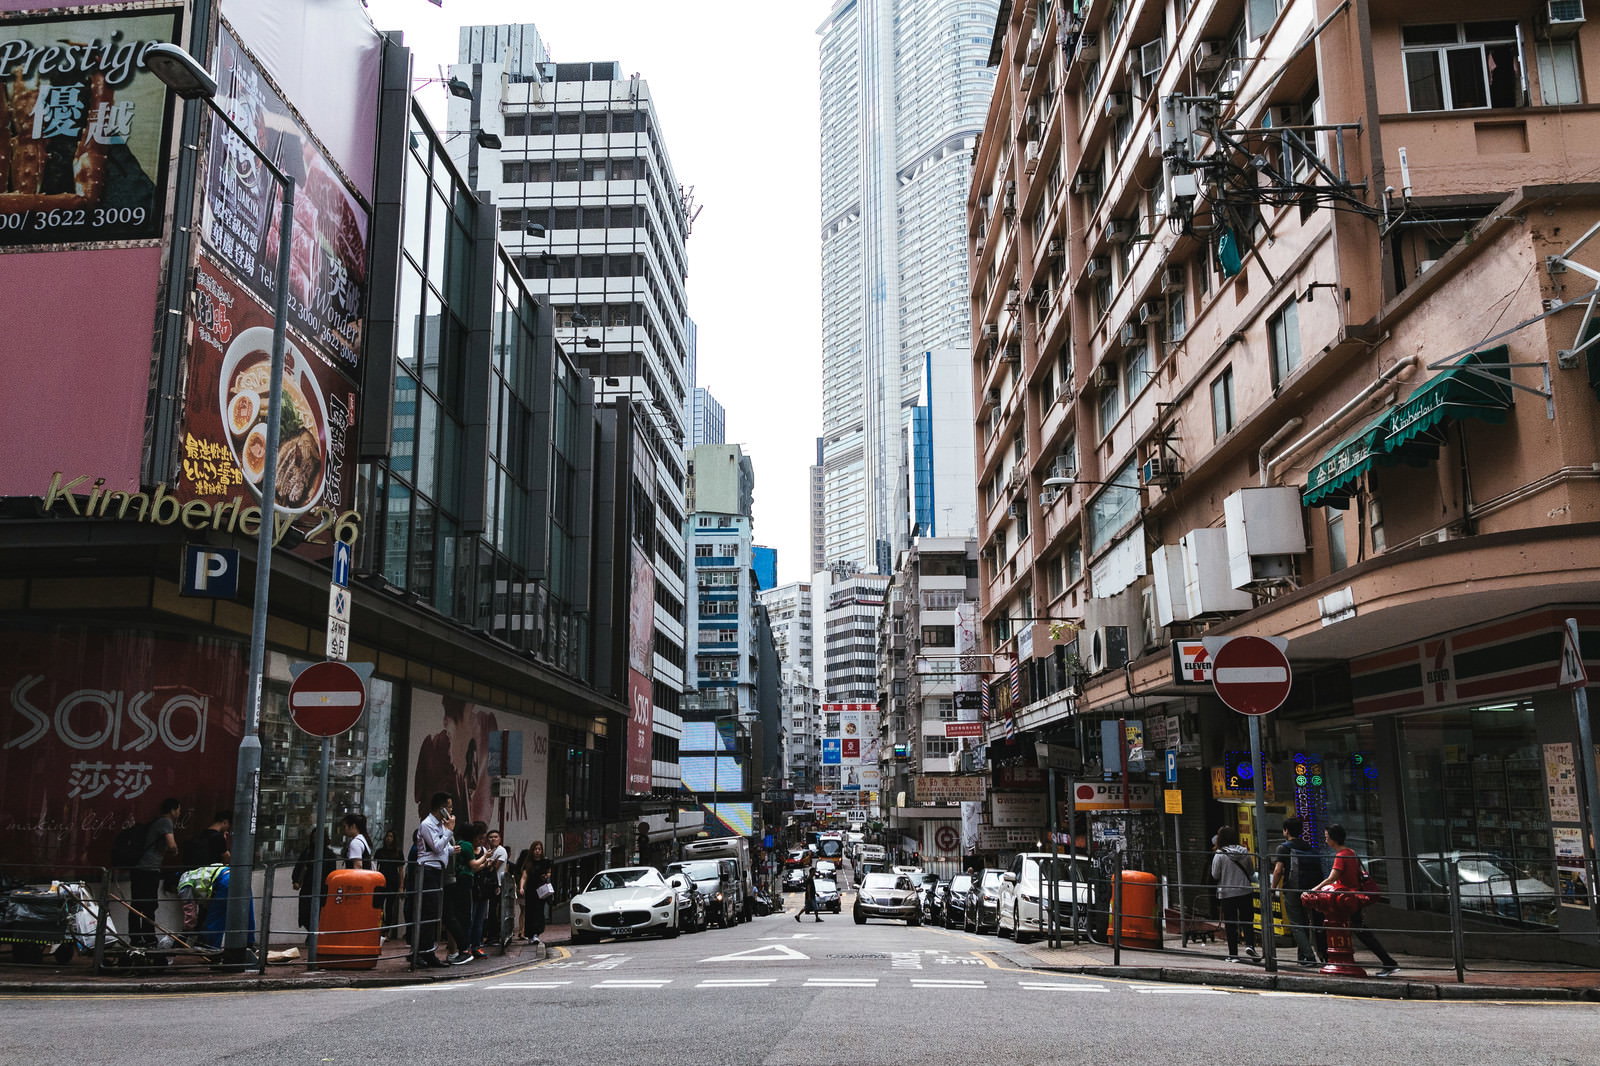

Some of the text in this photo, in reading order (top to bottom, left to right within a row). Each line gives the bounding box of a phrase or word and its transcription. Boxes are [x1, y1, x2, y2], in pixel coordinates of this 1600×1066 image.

[31, 82, 135, 145] 優越
[34, 209, 85, 230] 3622
[93, 207, 146, 228] 3009
[258, 264, 275, 293] Tel:
[321, 325, 339, 350] 3622
[340, 344, 358, 369] 3009
[313, 287, 358, 343] Wonder
[42, 470, 363, 549] Kimberley 26
[194, 552, 228, 590] P
[331, 638, 345, 656] 全日
[67, 760, 153, 800] 莎莎
[1168, 754, 1175, 780] P
